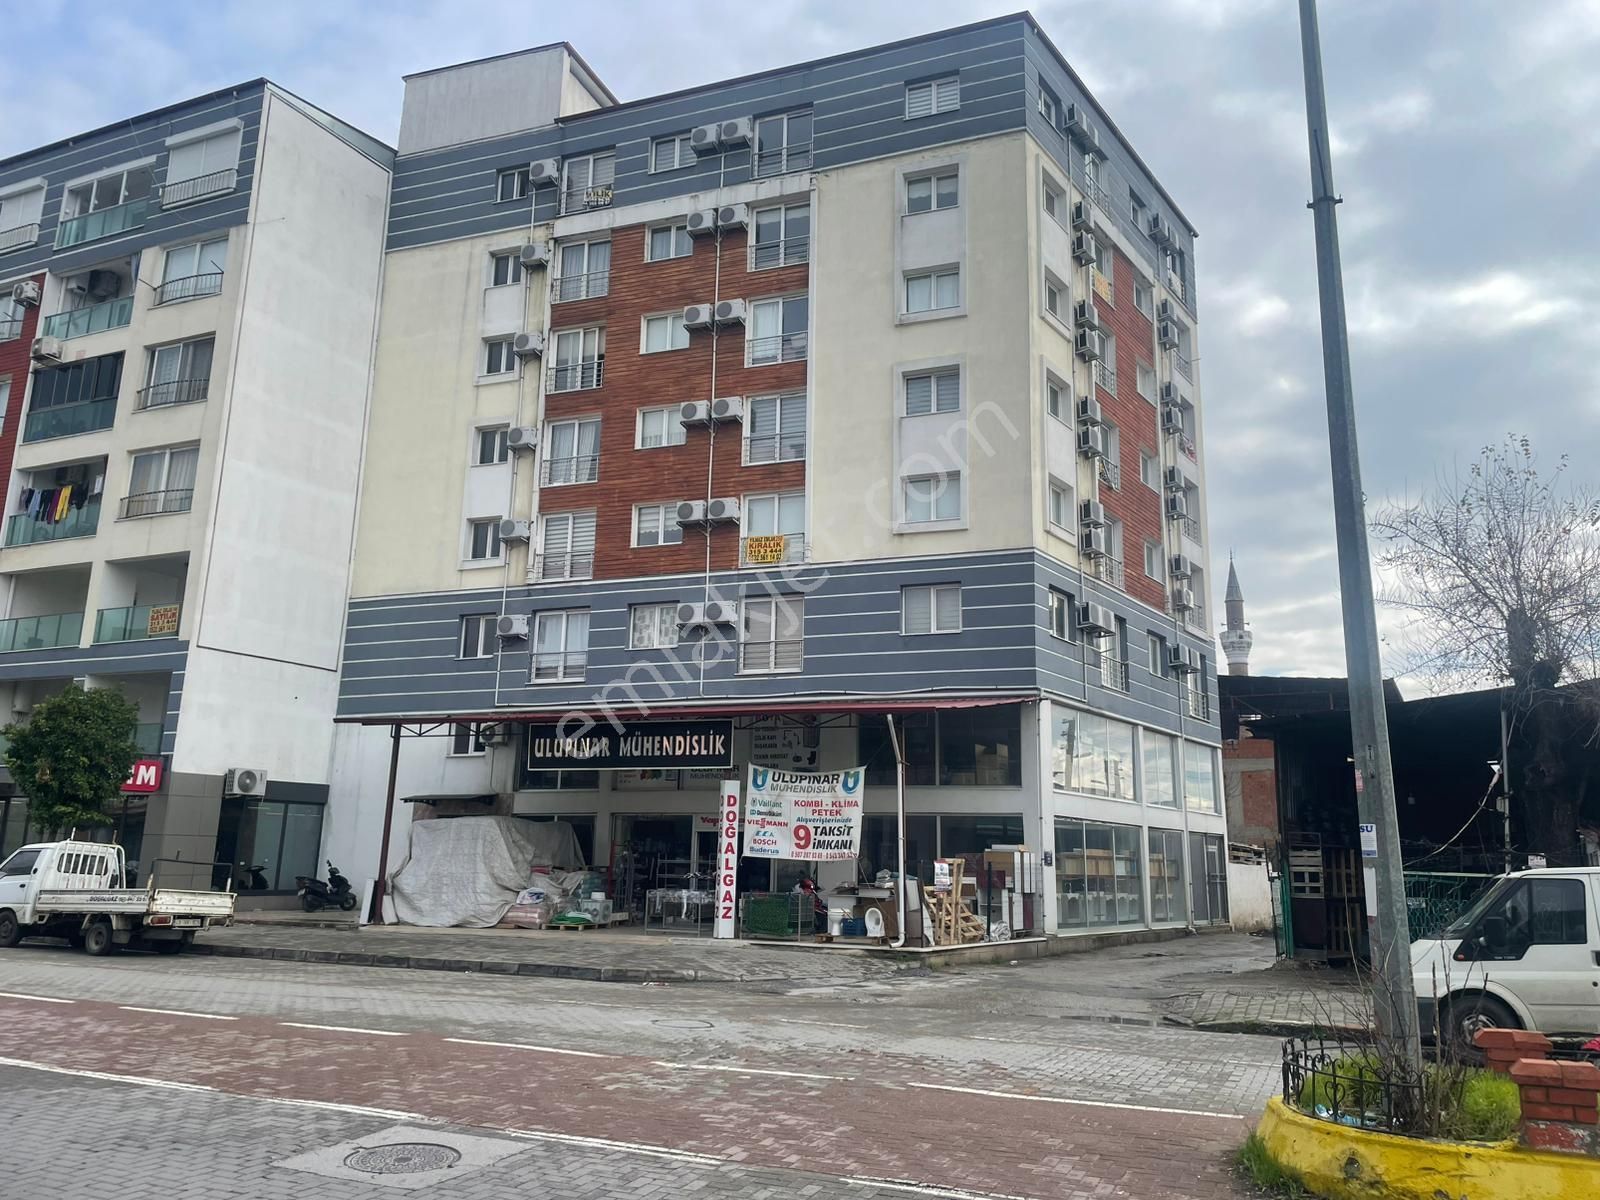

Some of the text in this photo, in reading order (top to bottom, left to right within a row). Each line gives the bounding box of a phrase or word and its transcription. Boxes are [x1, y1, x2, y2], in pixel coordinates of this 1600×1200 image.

[534, 730, 726, 758] ULUPINAR MÜHENDİSLİK
[771, 771, 841, 784] ULUPINAR
[758, 799, 782, 808] Vaillant
[752, 838, 777, 846] BOSCH
[793, 824, 812, 850] 9
[721, 794, 738, 920] DOĞALGAZ
